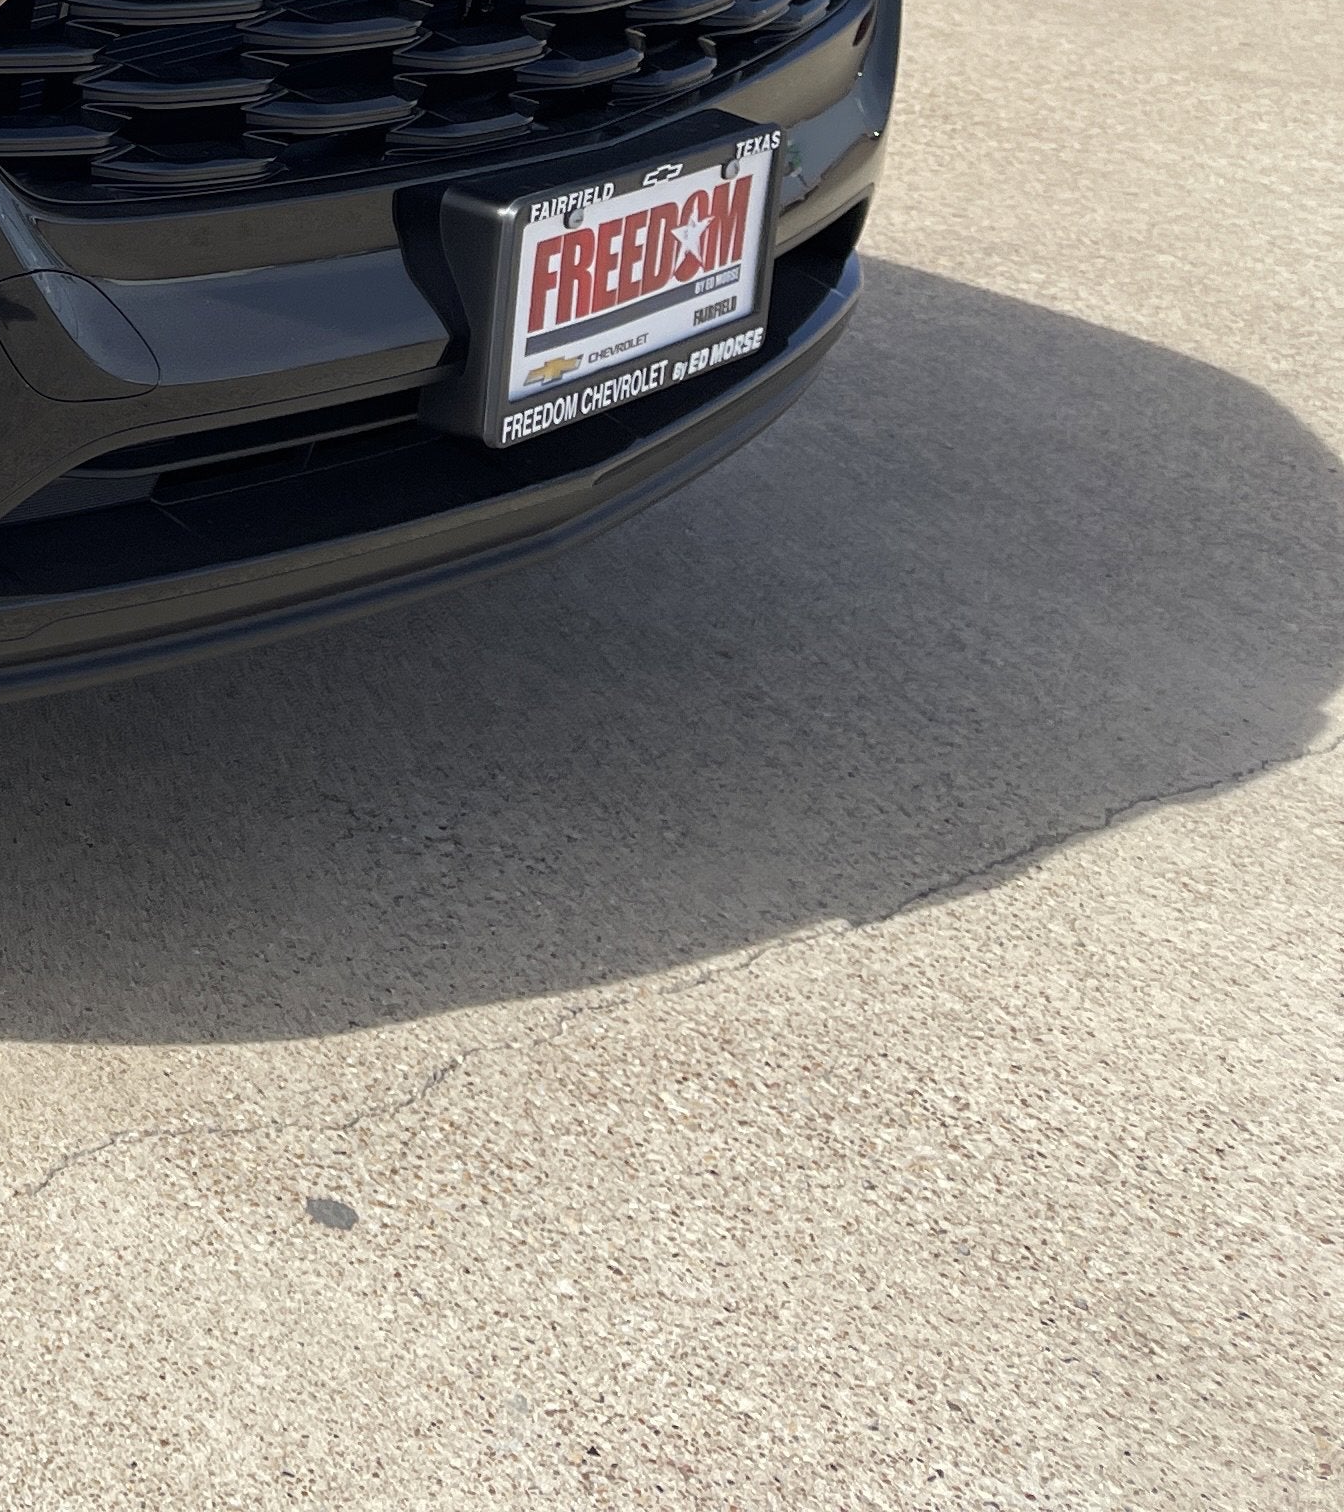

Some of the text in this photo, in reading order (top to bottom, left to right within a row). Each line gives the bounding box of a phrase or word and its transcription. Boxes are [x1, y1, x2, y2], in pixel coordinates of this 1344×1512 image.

[530, 130, 782, 224] FAIRFIELD TEXAS
[527, 176, 751, 334] FREEDOM
[501, 391, 579, 444] FREEDOM
[580, 360, 669, 415] CHEVROLET
[688, 347, 711, 373] ED
[709, 327, 764, 363] MORSE
[587, 332, 650, 365] CHEVROLET
